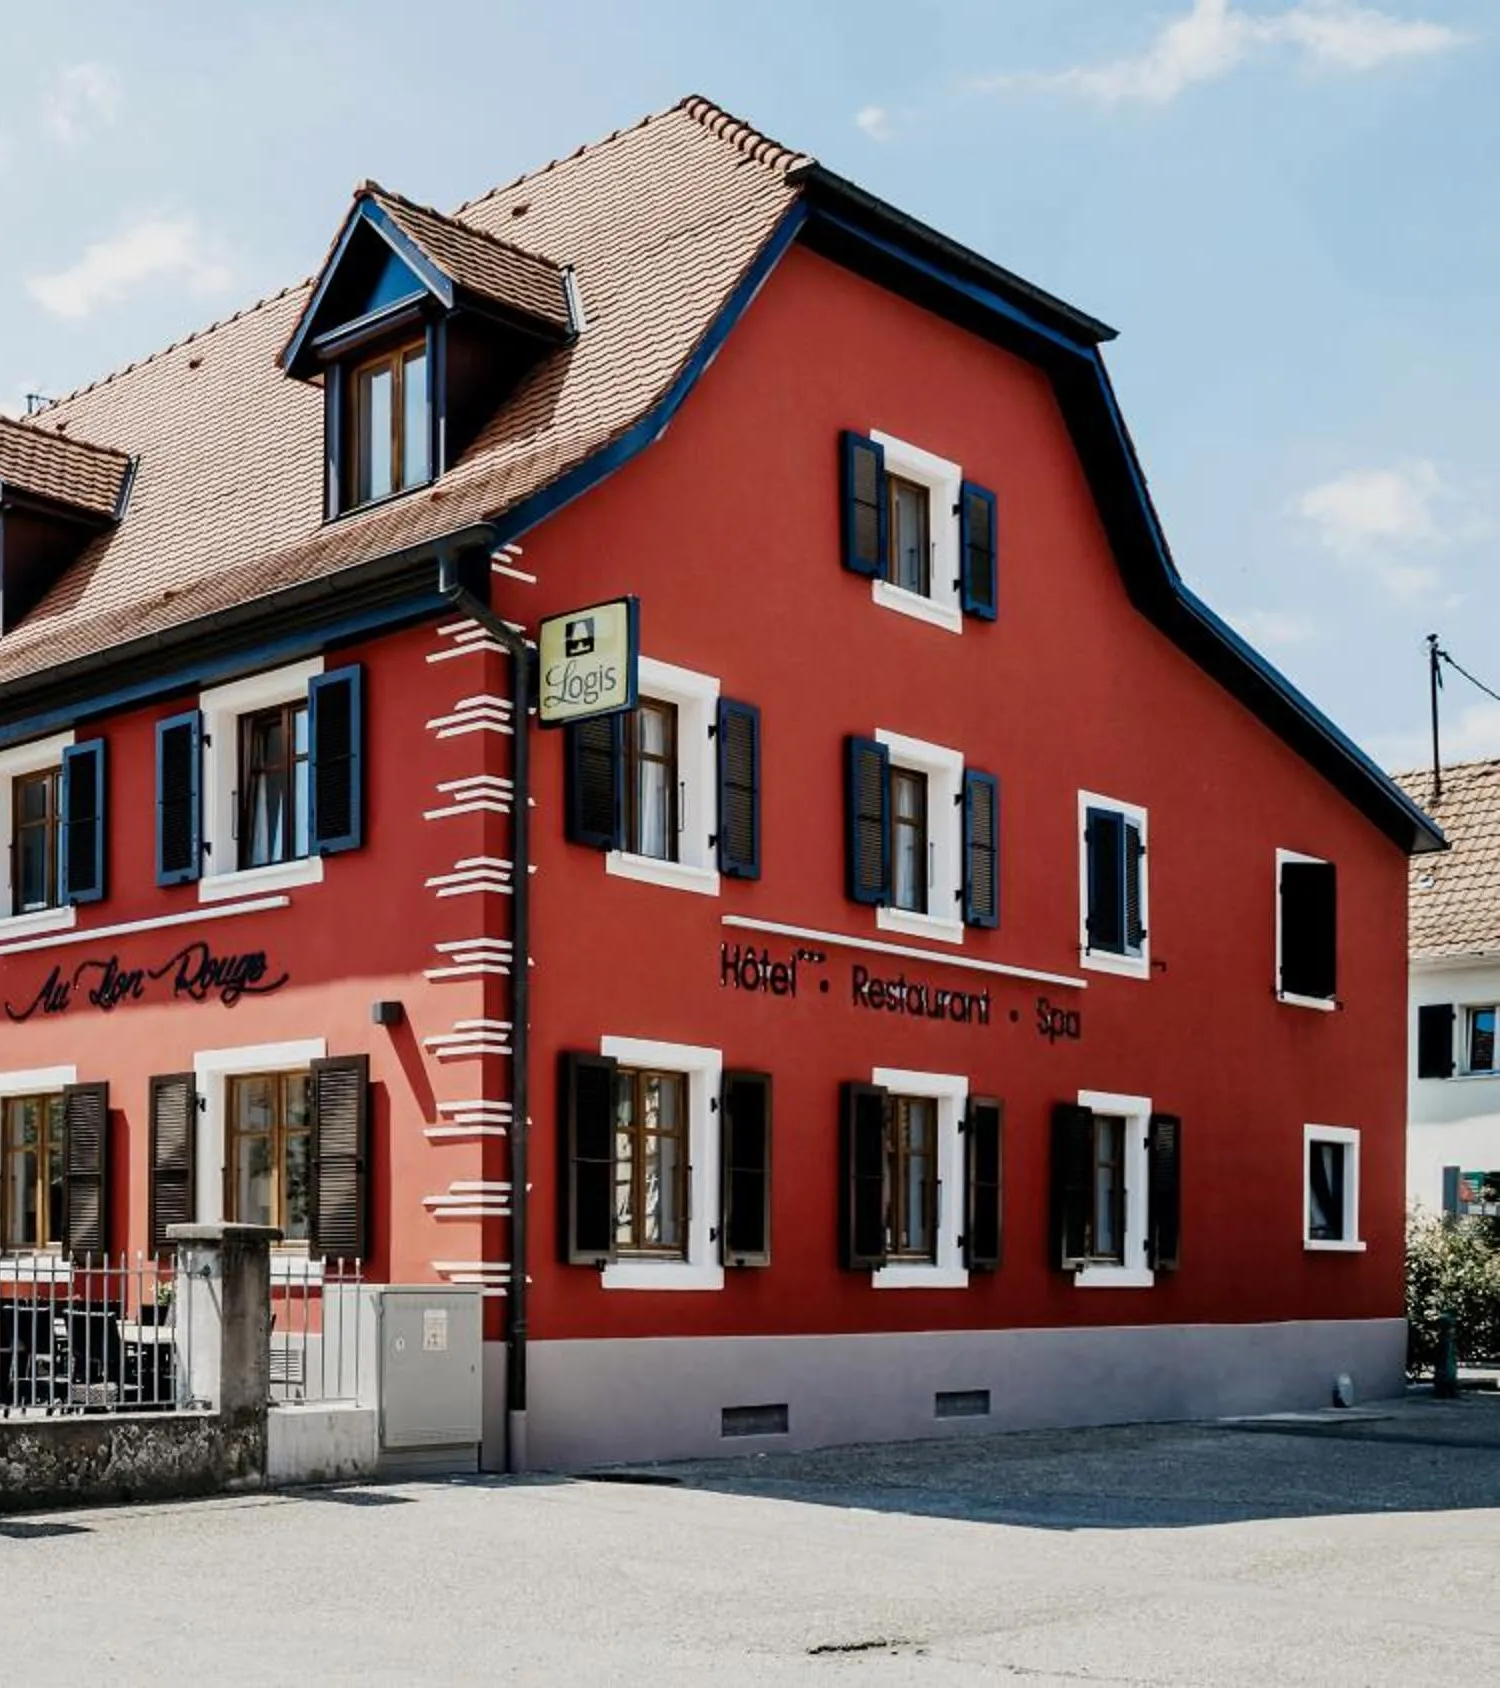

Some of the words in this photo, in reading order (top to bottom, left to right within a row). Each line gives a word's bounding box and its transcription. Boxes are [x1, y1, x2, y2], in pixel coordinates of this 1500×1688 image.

[544, 660, 618, 709] Logis
[4, 965, 72, 1023] Au
[147, 940, 291, 1009] Rouge
[851, 964, 992, 1026] Restaurant
[1035, 996, 1082, 1045] Spa
